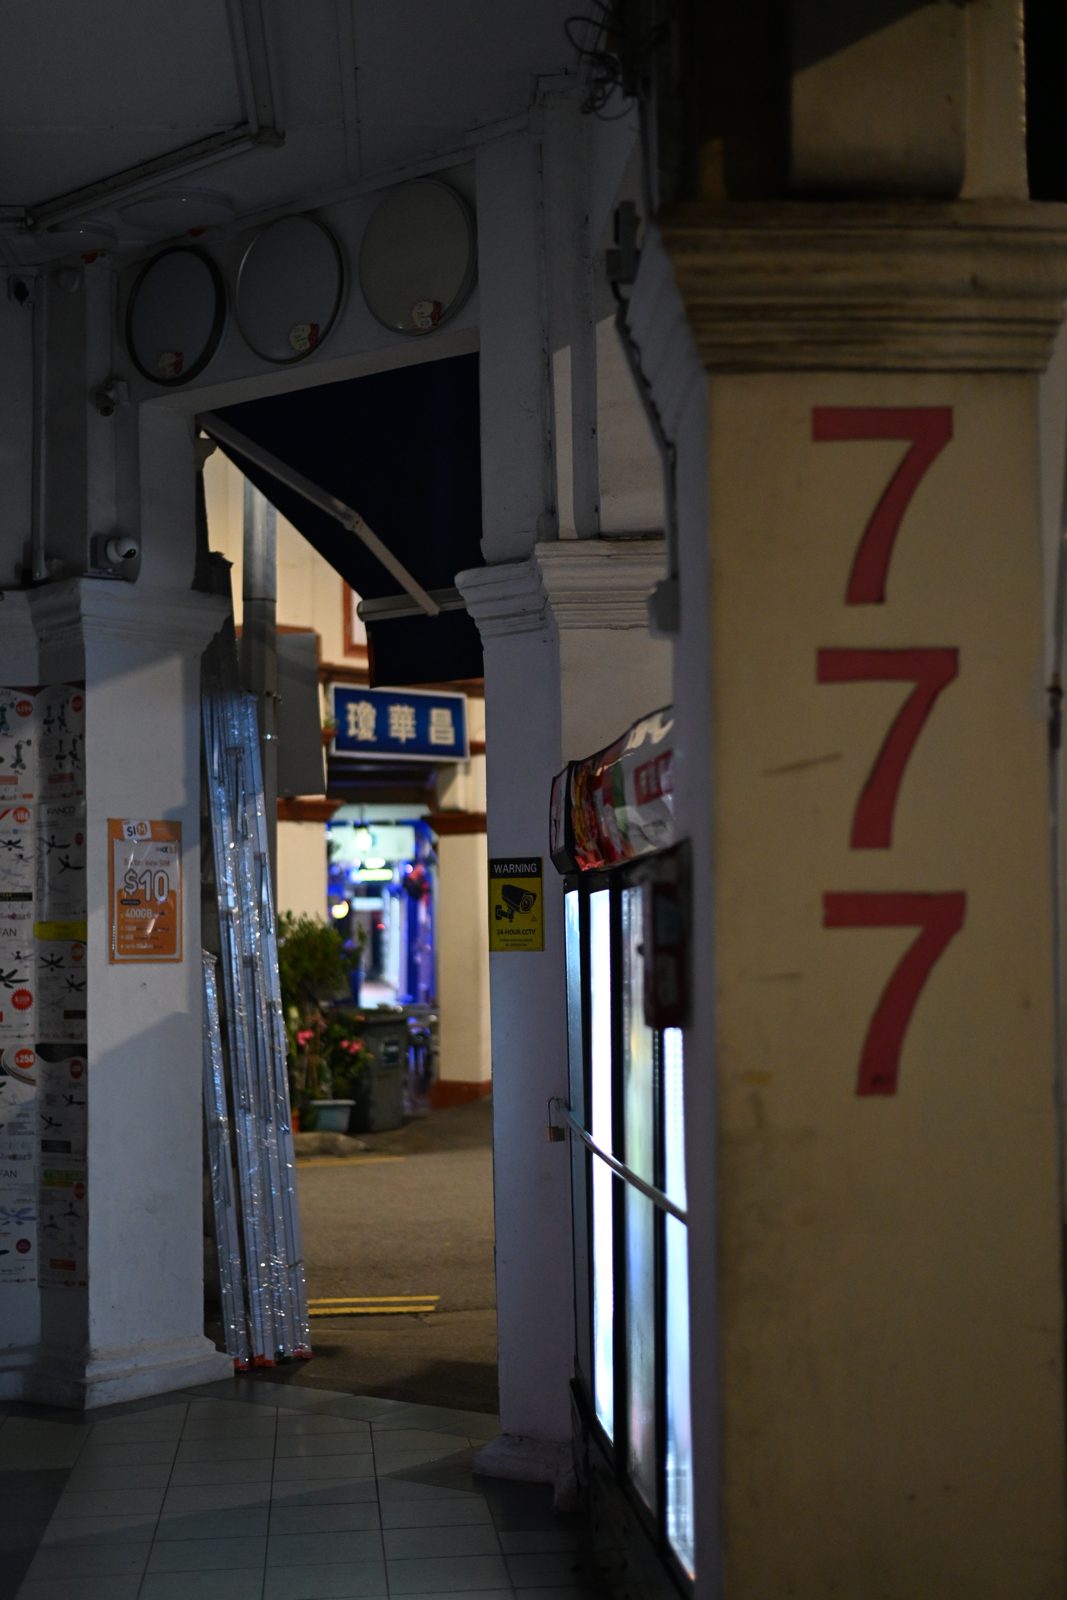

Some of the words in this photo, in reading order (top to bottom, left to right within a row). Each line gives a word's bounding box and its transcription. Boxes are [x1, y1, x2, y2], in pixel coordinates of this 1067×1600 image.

[494, 863, 537, 873] WARNING
[124, 869, 169, 903] $10
[522, 928, 536, 936] CCTV
